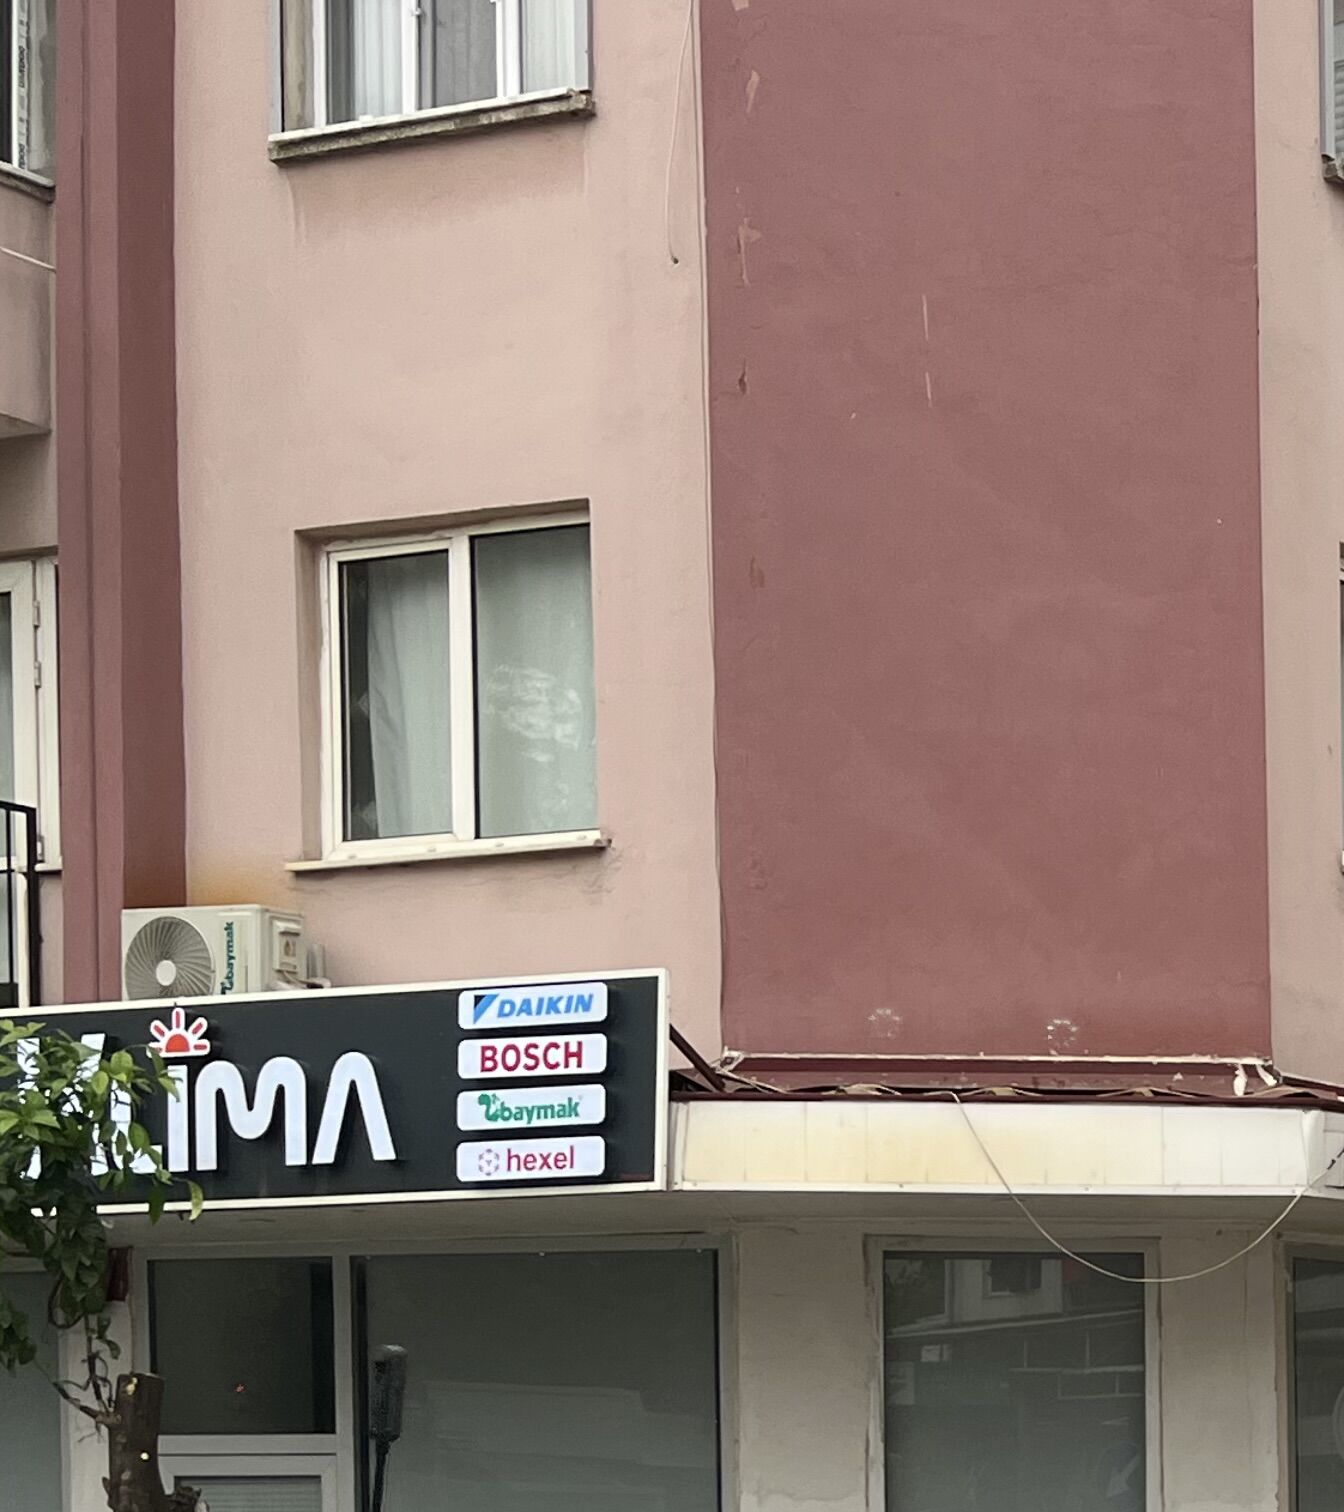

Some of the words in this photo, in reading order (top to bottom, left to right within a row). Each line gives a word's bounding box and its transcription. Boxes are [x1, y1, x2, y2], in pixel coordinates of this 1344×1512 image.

[496, 993, 594, 1018] DAIKIN
[480, 1041, 583, 1073] BOSCH
[499, 1097, 580, 1124] baymak
[507, 1145, 574, 1171] hexel
